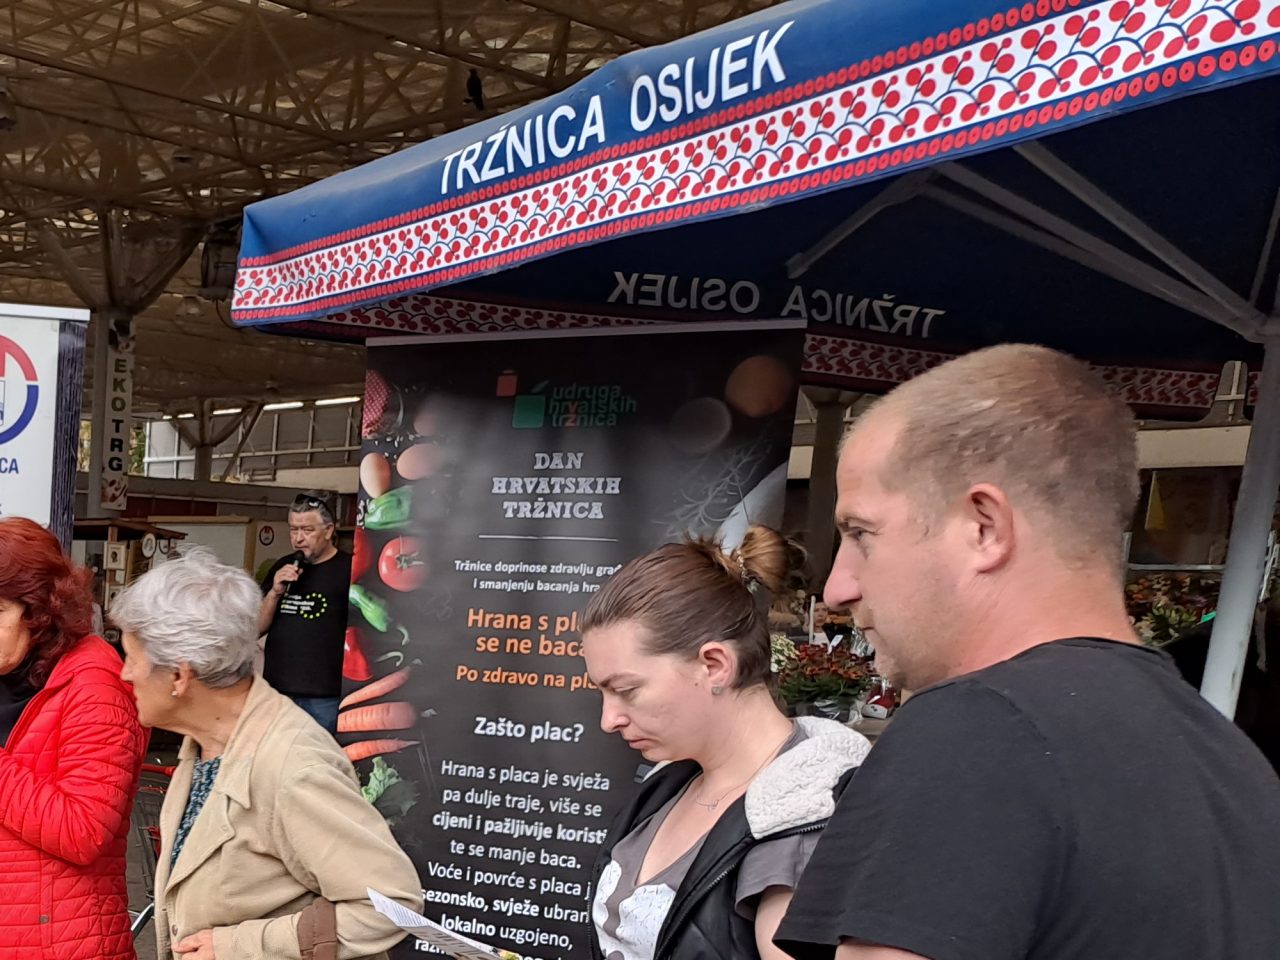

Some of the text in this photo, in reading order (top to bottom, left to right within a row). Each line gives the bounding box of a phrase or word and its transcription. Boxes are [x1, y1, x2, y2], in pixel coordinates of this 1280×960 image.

[440, 20, 795, 194] TRŽNICA OSIJEK
[553, 383, 621, 402] udruga
[549, 396, 637, 415] hrvatskih
[534, 453, 584, 470] DAN
[492, 477, 621, 494] HRVATSKIH
[503, 497, 604, 519] TRŽNICA
[454, 560, 492, 572] Tržnice
[494, 561, 547, 573] doprinose
[550, 563, 593, 575] zdravlju
[479, 579, 579, 594] smanjenju bacanja
[468, 608, 531, 630] Hrana
[538, 614, 548, 631] s
[476, 635, 500, 652] se
[506, 637, 532, 654] ne
[456, 665, 478, 681] Po
[482, 666, 538, 686] zdravo
[544, 674, 565, 688] na
[474, 717, 584, 743] Zašto plac?
[441, 760, 610, 791] Hrana s placa je svježa
[443, 788, 602, 817] pa dulje traje, više se
[432, 811, 472, 831] cijeni
[476, 815, 481, 831] i
[484, 816, 553, 840] pažljivije
[450, 839, 582, 869] te se manje baca.
[428, 861, 463, 880] Voće
[466, 865, 471, 881] i
[474, 868, 525, 889] povrće
[529, 876, 536, 890] s
[540, 876, 582, 897] placa
[421, 888, 489, 911] sezonsko,
[493, 898, 540, 918] svježe
[441, 914, 573, 950] lokalno uzgojeno,
